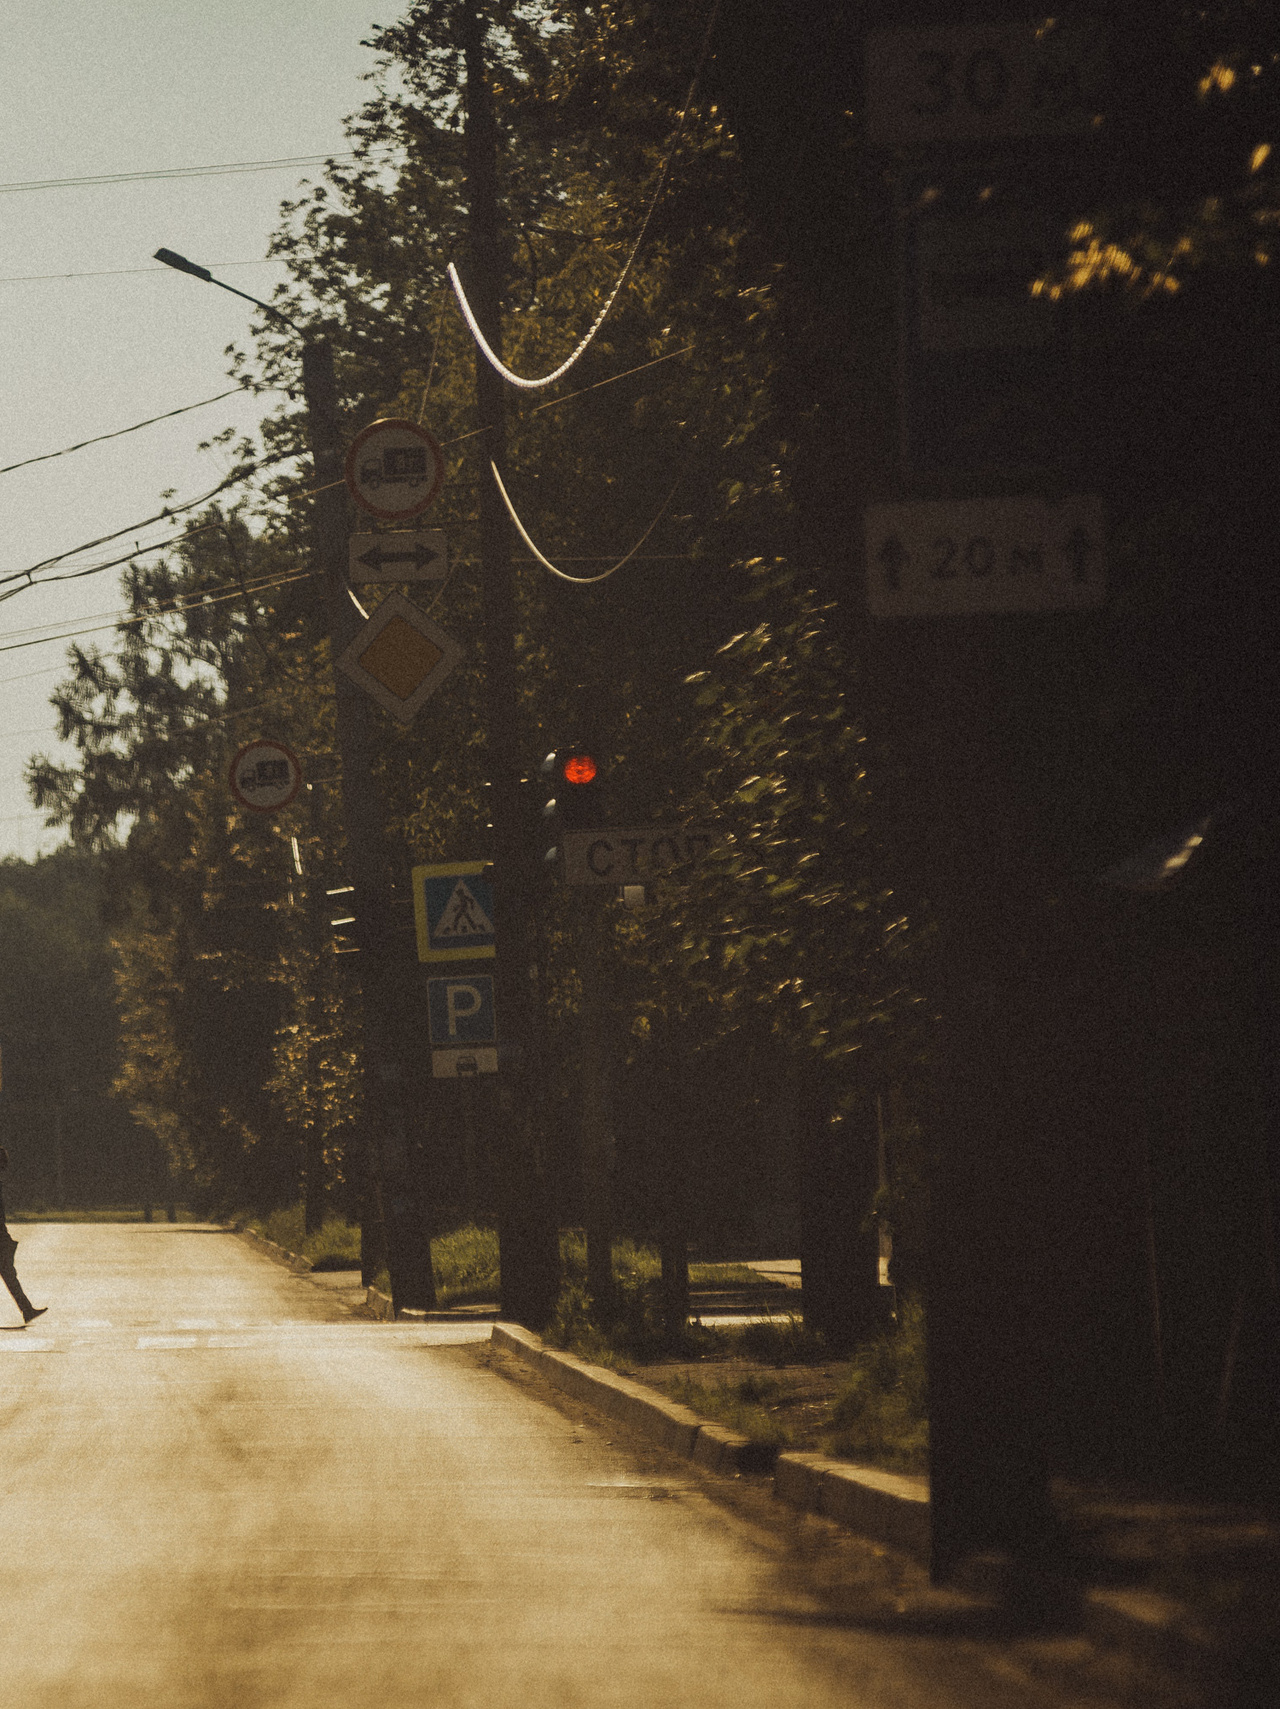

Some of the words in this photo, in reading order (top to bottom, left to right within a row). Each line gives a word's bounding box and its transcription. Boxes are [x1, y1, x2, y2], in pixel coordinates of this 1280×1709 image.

[913, 49, 1010, 115] 30
[930, 536, 995, 579] 20
[446, 984, 483, 1035] P
